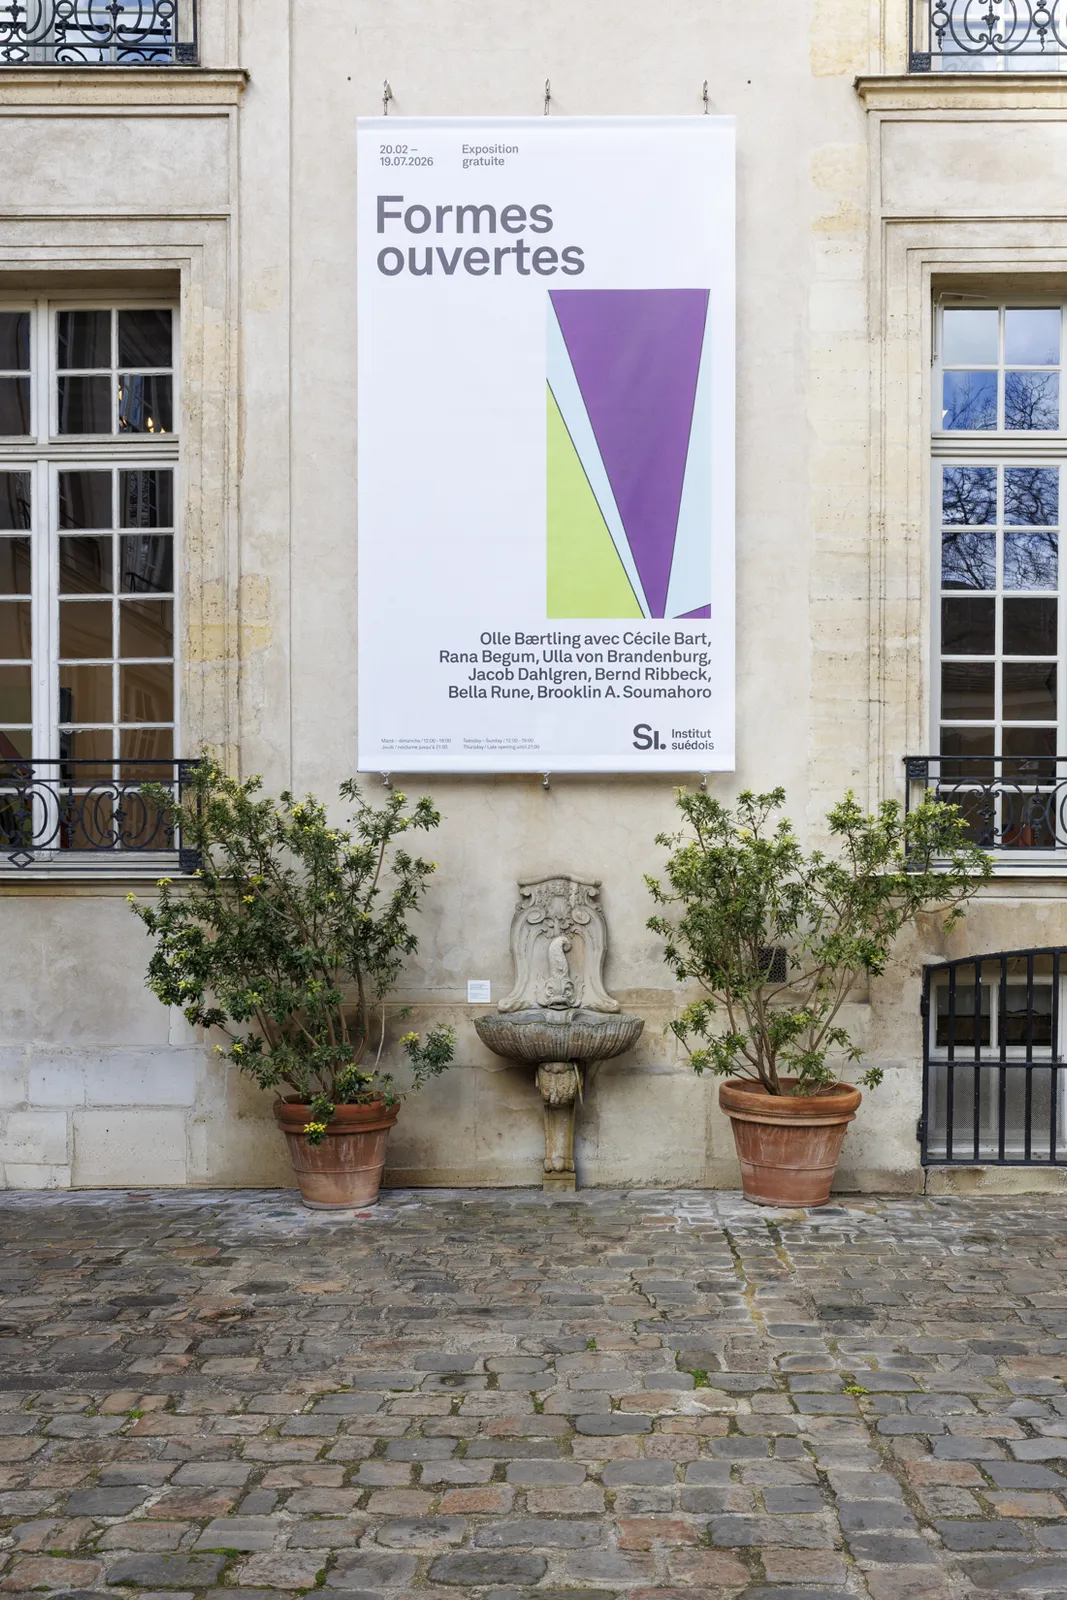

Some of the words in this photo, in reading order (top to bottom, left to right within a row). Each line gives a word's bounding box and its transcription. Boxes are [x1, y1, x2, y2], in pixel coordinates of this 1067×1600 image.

[379, 144, 408, 155] 20.02
[462, 144, 519, 156] Exposition
[379, 156, 434, 167] 19.07.2026
[462, 156, 505, 169] gratuite
[377, 195, 554, 234] Formes
[376, 238, 586, 277] ouvertes
[480, 631, 511, 646] Olle
[514, 631, 581, 649] Bærtling
[583, 634, 620, 646] avec
[622, 631, 671, 646] Cécile
[674, 631, 712, 648] Bart,
[439, 649, 479, 664] Rana
[481, 649, 540, 667] Begum,
[542, 649, 573, 664] Ulla
[575, 652, 604, 664] von
[607, 649, 712, 667] Brandenburg,
[468, 667, 515, 682] Jacob
[517, 666, 592, 685] Dahlgren,
[594, 667, 641, 682] Bernd
[644, 666, 712, 684] Ribbeck,
[448, 684, 488, 699] Bella
[490, 684, 535, 701] Rune,
[537, 684, 602, 699] Brooklin
[604, 684, 621, 699] A.
[622, 684, 712, 699] Soumahoro
[671, 728, 712, 739] Institut
[671, 739, 715, 751] suédois
